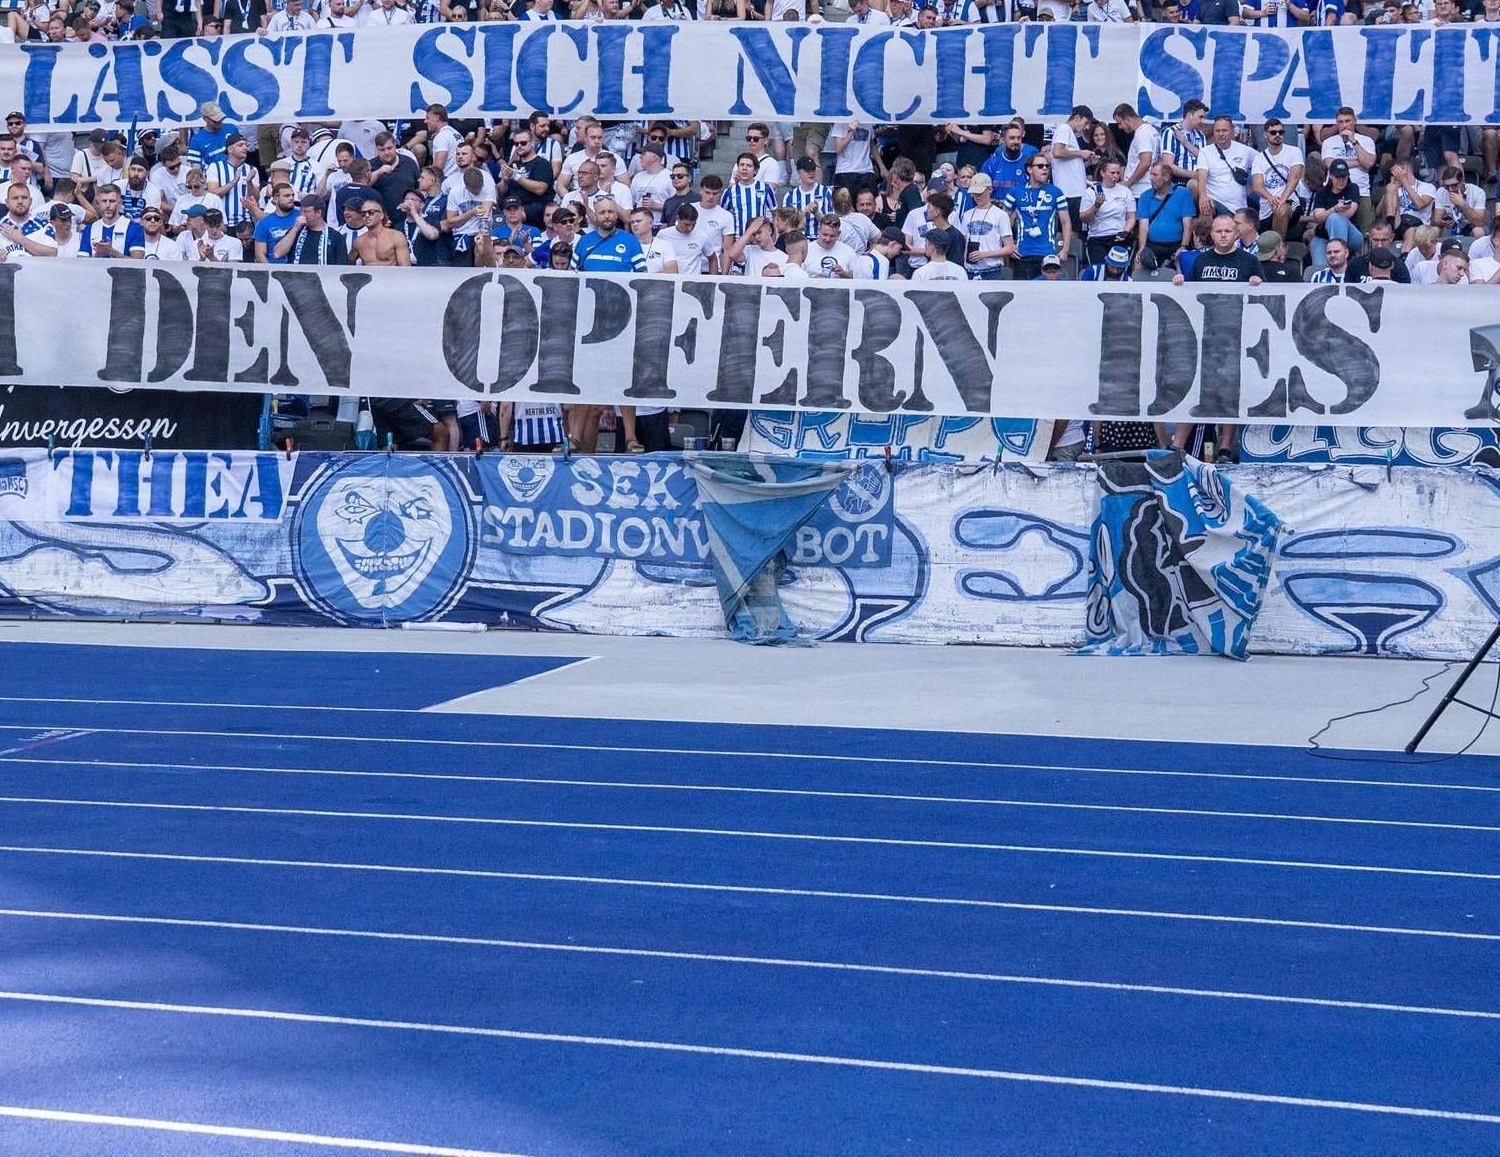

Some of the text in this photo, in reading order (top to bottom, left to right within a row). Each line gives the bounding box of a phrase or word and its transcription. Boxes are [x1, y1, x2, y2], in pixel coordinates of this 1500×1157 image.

[20, 29, 354, 130] LÄSST
[409, 21, 674, 119] SICH
[728, 25, 1101, 122] NICHT
[98, 264, 370, 389] DEN
[442, 271, 1015, 414] OPFERN
[1088, 284, 1383, 417] DES
[53, 449, 296, 522] THEA
[570, 457, 708, 511] SEK
